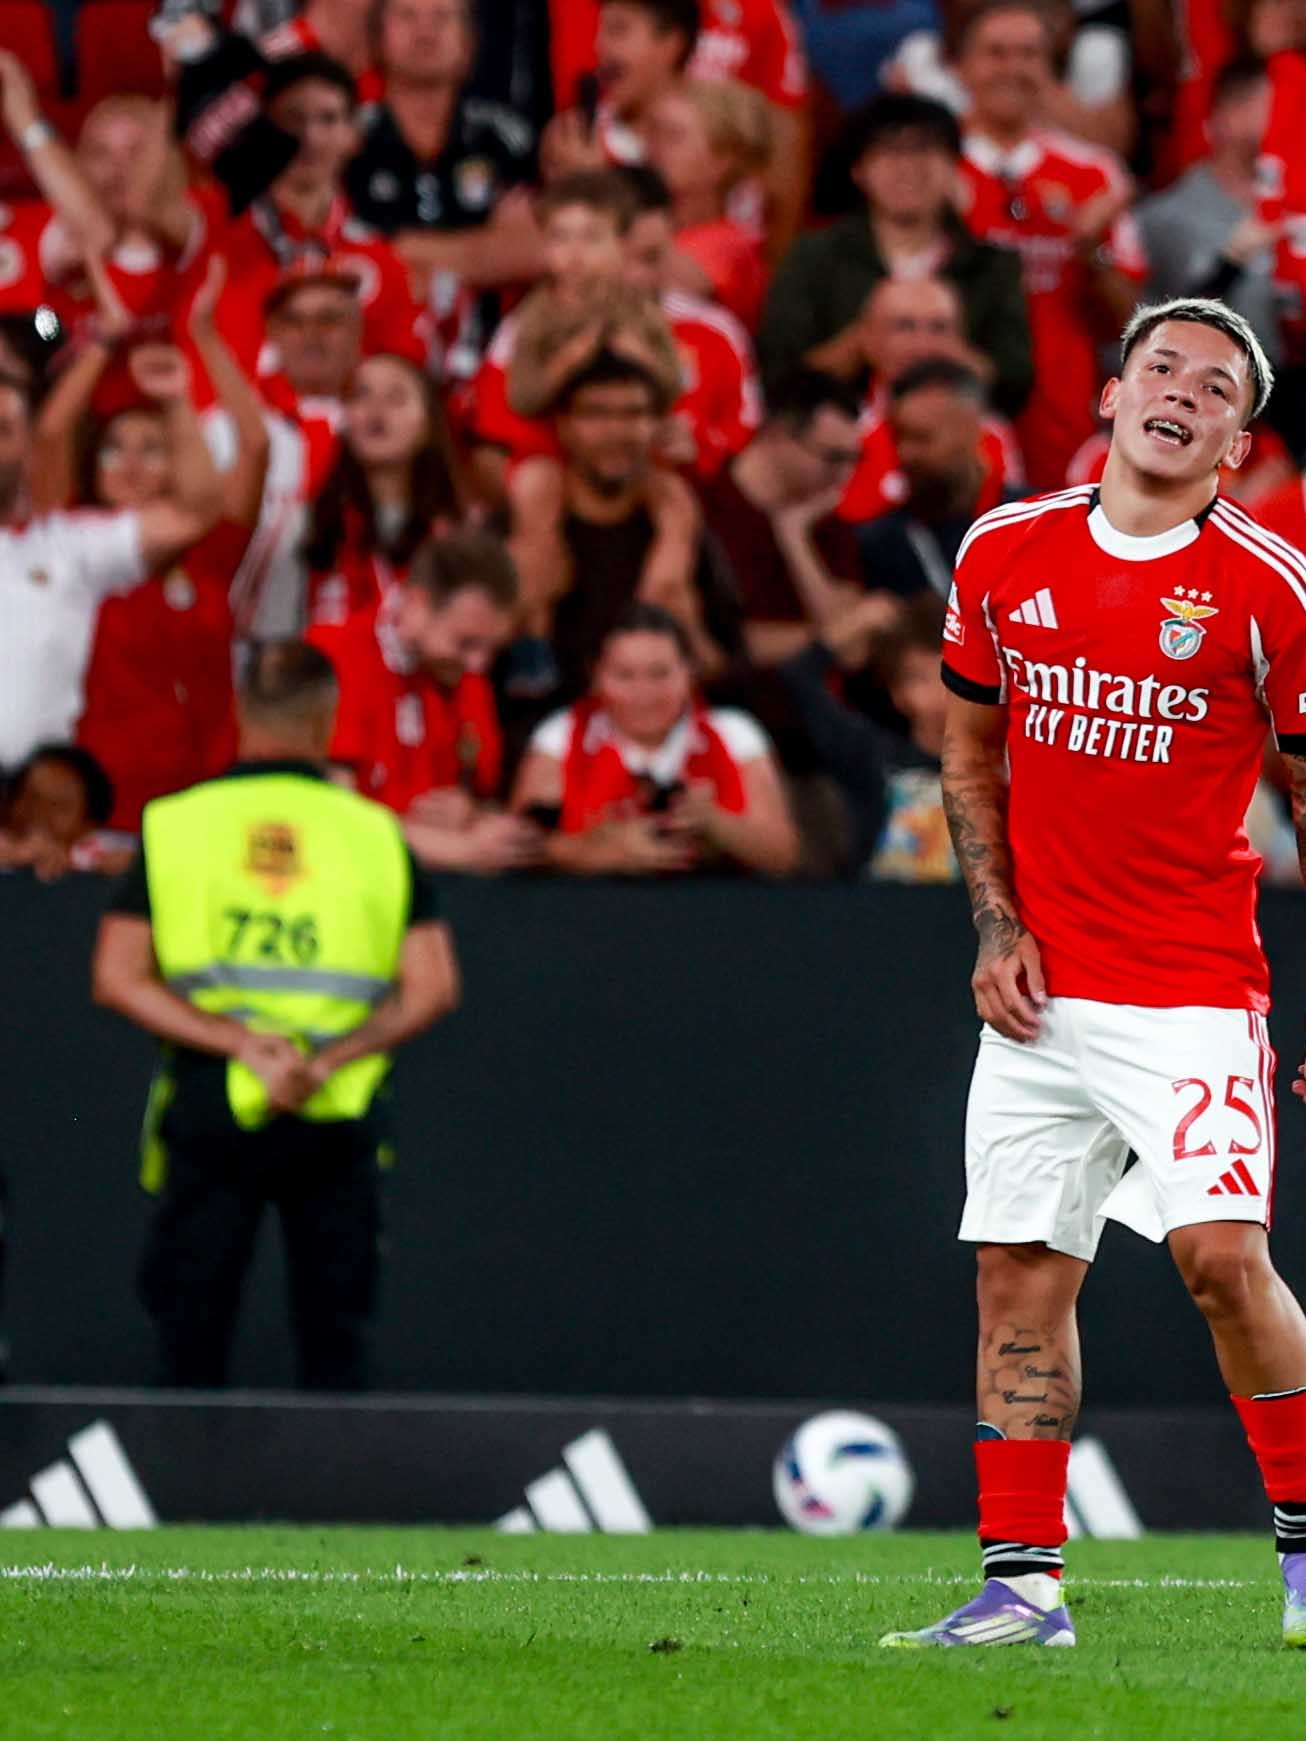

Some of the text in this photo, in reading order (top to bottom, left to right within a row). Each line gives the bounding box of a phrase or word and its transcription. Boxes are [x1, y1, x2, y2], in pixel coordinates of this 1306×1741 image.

[1002, 647, 1209, 722] Emirates
[1025, 703, 1174, 764] FLY BETTER
[225, 908, 319, 963] 726
[1171, 1074, 1263, 1162] 25
